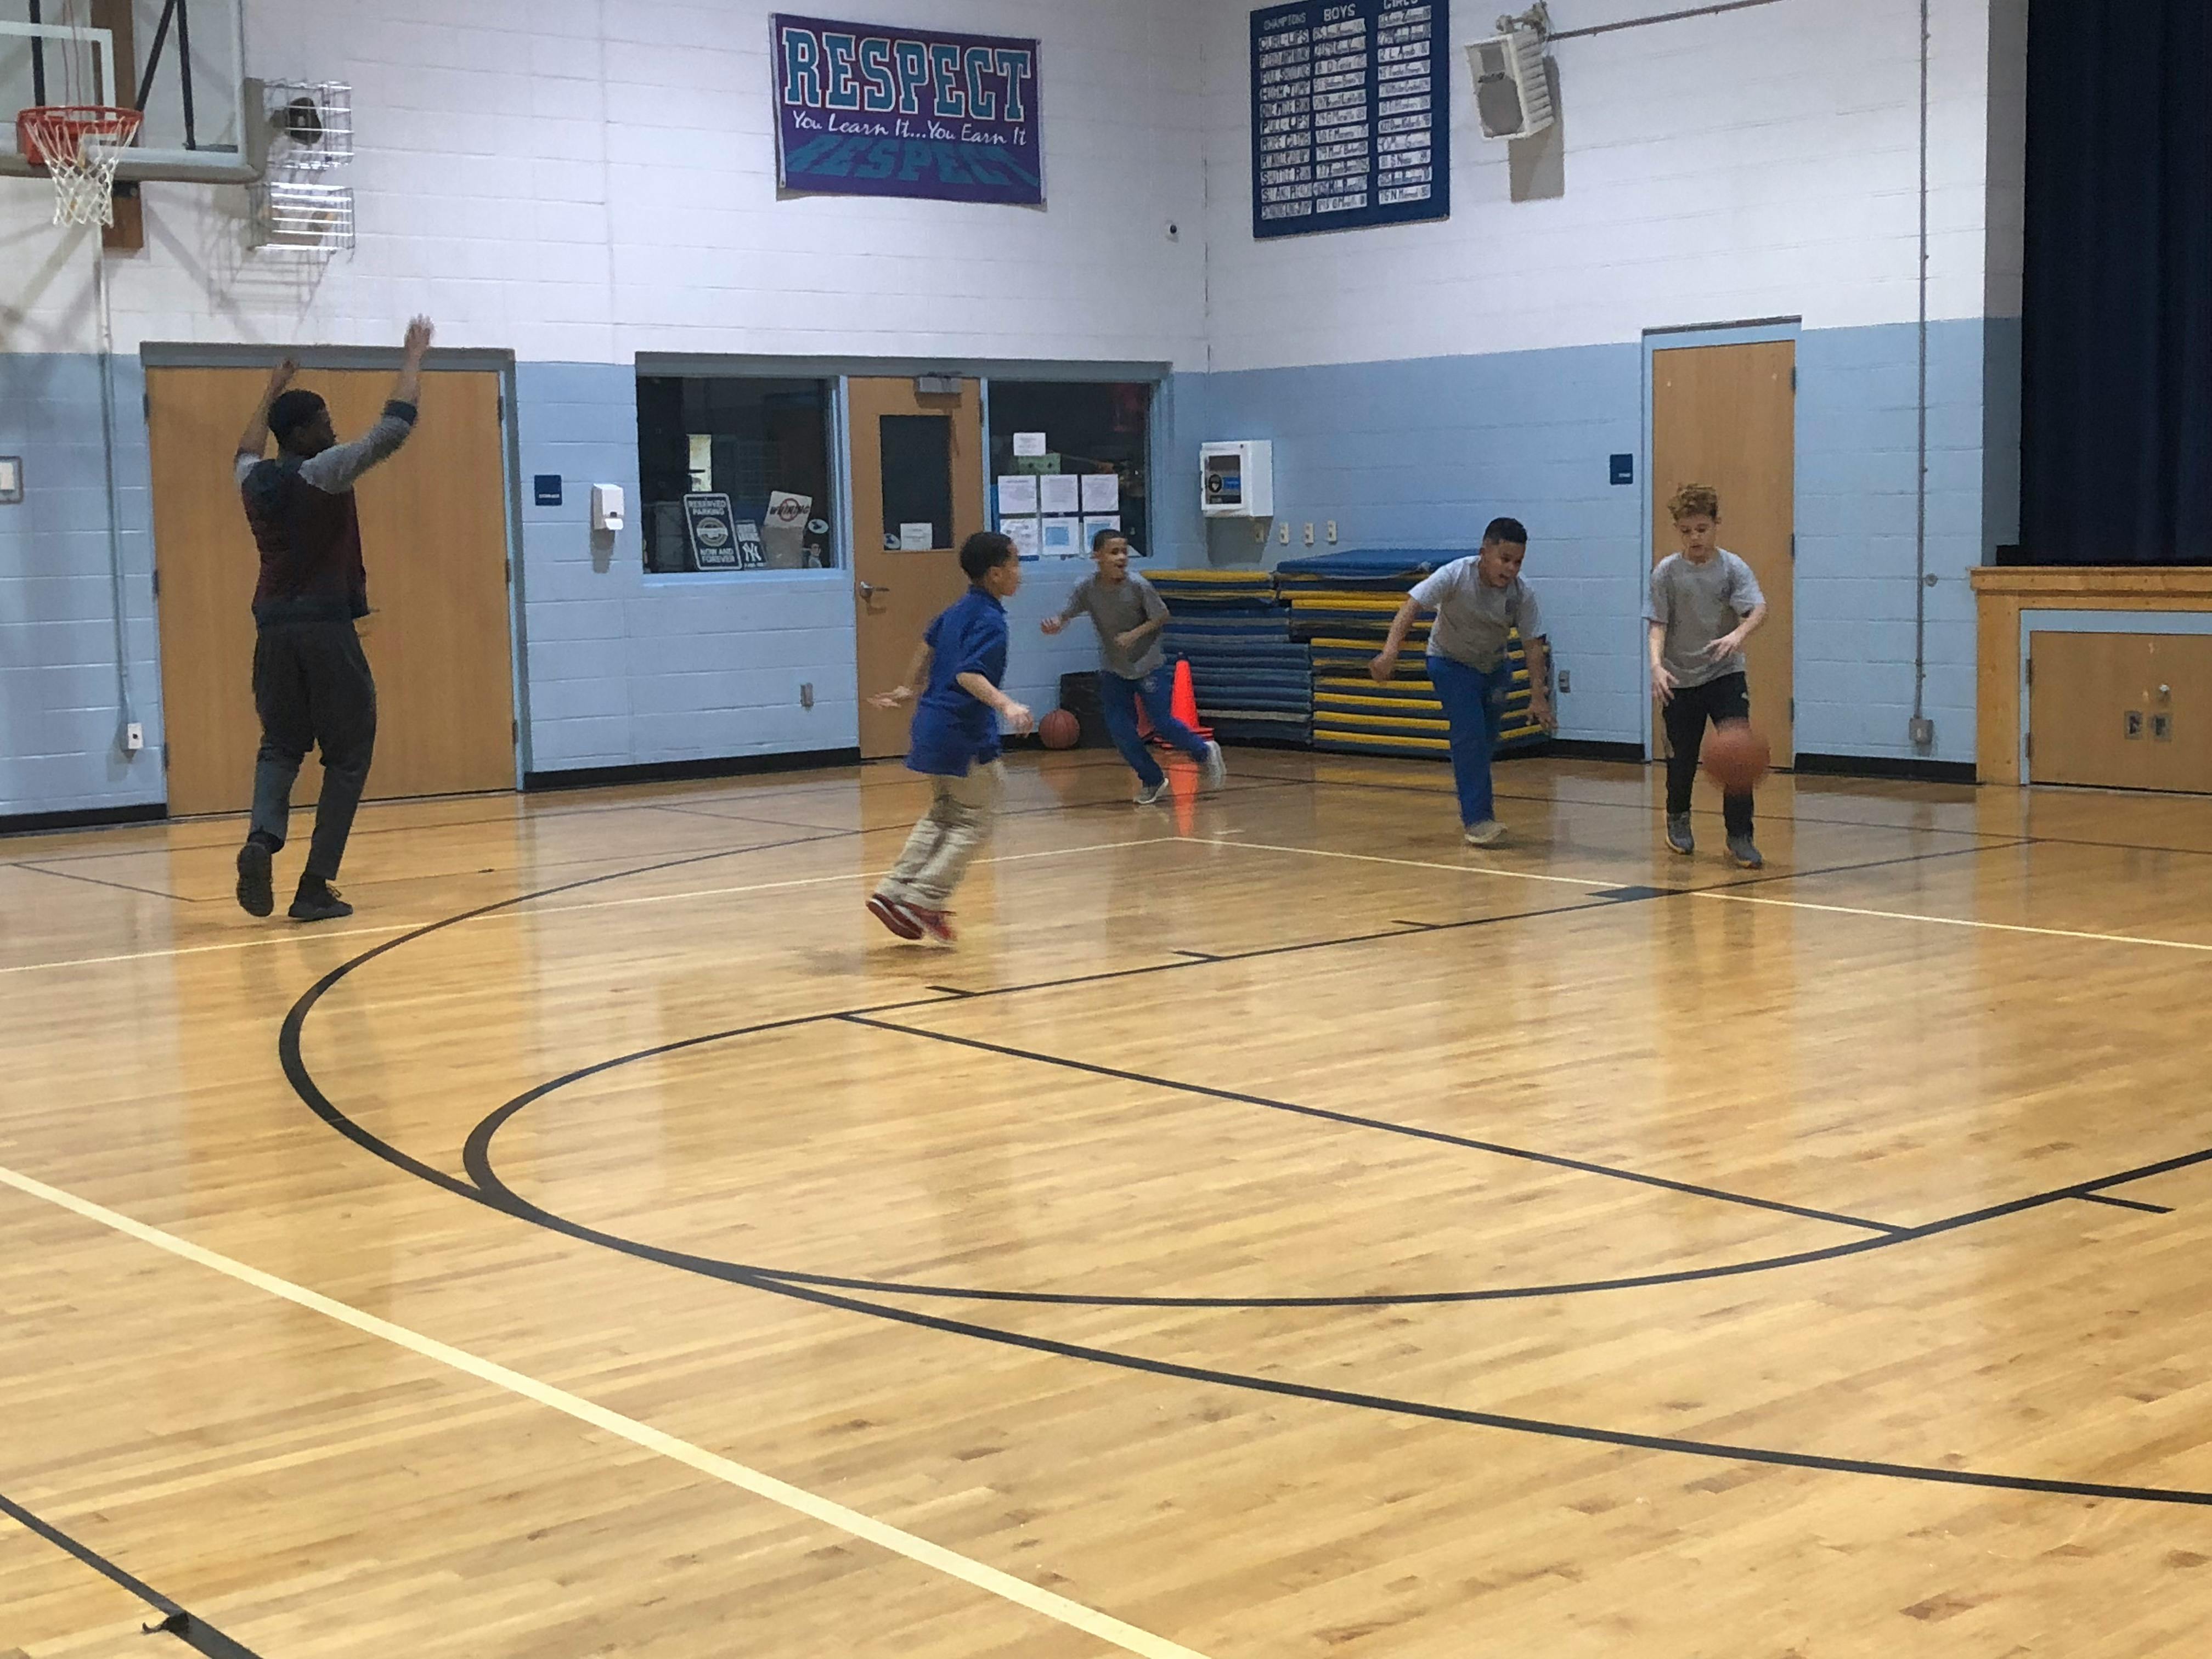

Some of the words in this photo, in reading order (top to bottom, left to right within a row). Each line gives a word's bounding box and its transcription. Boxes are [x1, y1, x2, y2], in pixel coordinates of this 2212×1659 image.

[1324, 3, 1356, 21] BOYS
[782, 26, 1031, 122] RESPECT
[793, 110, 822, 130] You
[828, 113, 889, 136] Learn
[961, 123, 1007, 145] Earn
[1014, 127, 1027, 146] It
[785, 134, 1039, 187] RESPECT
[689, 500, 726, 508] RESERVED
